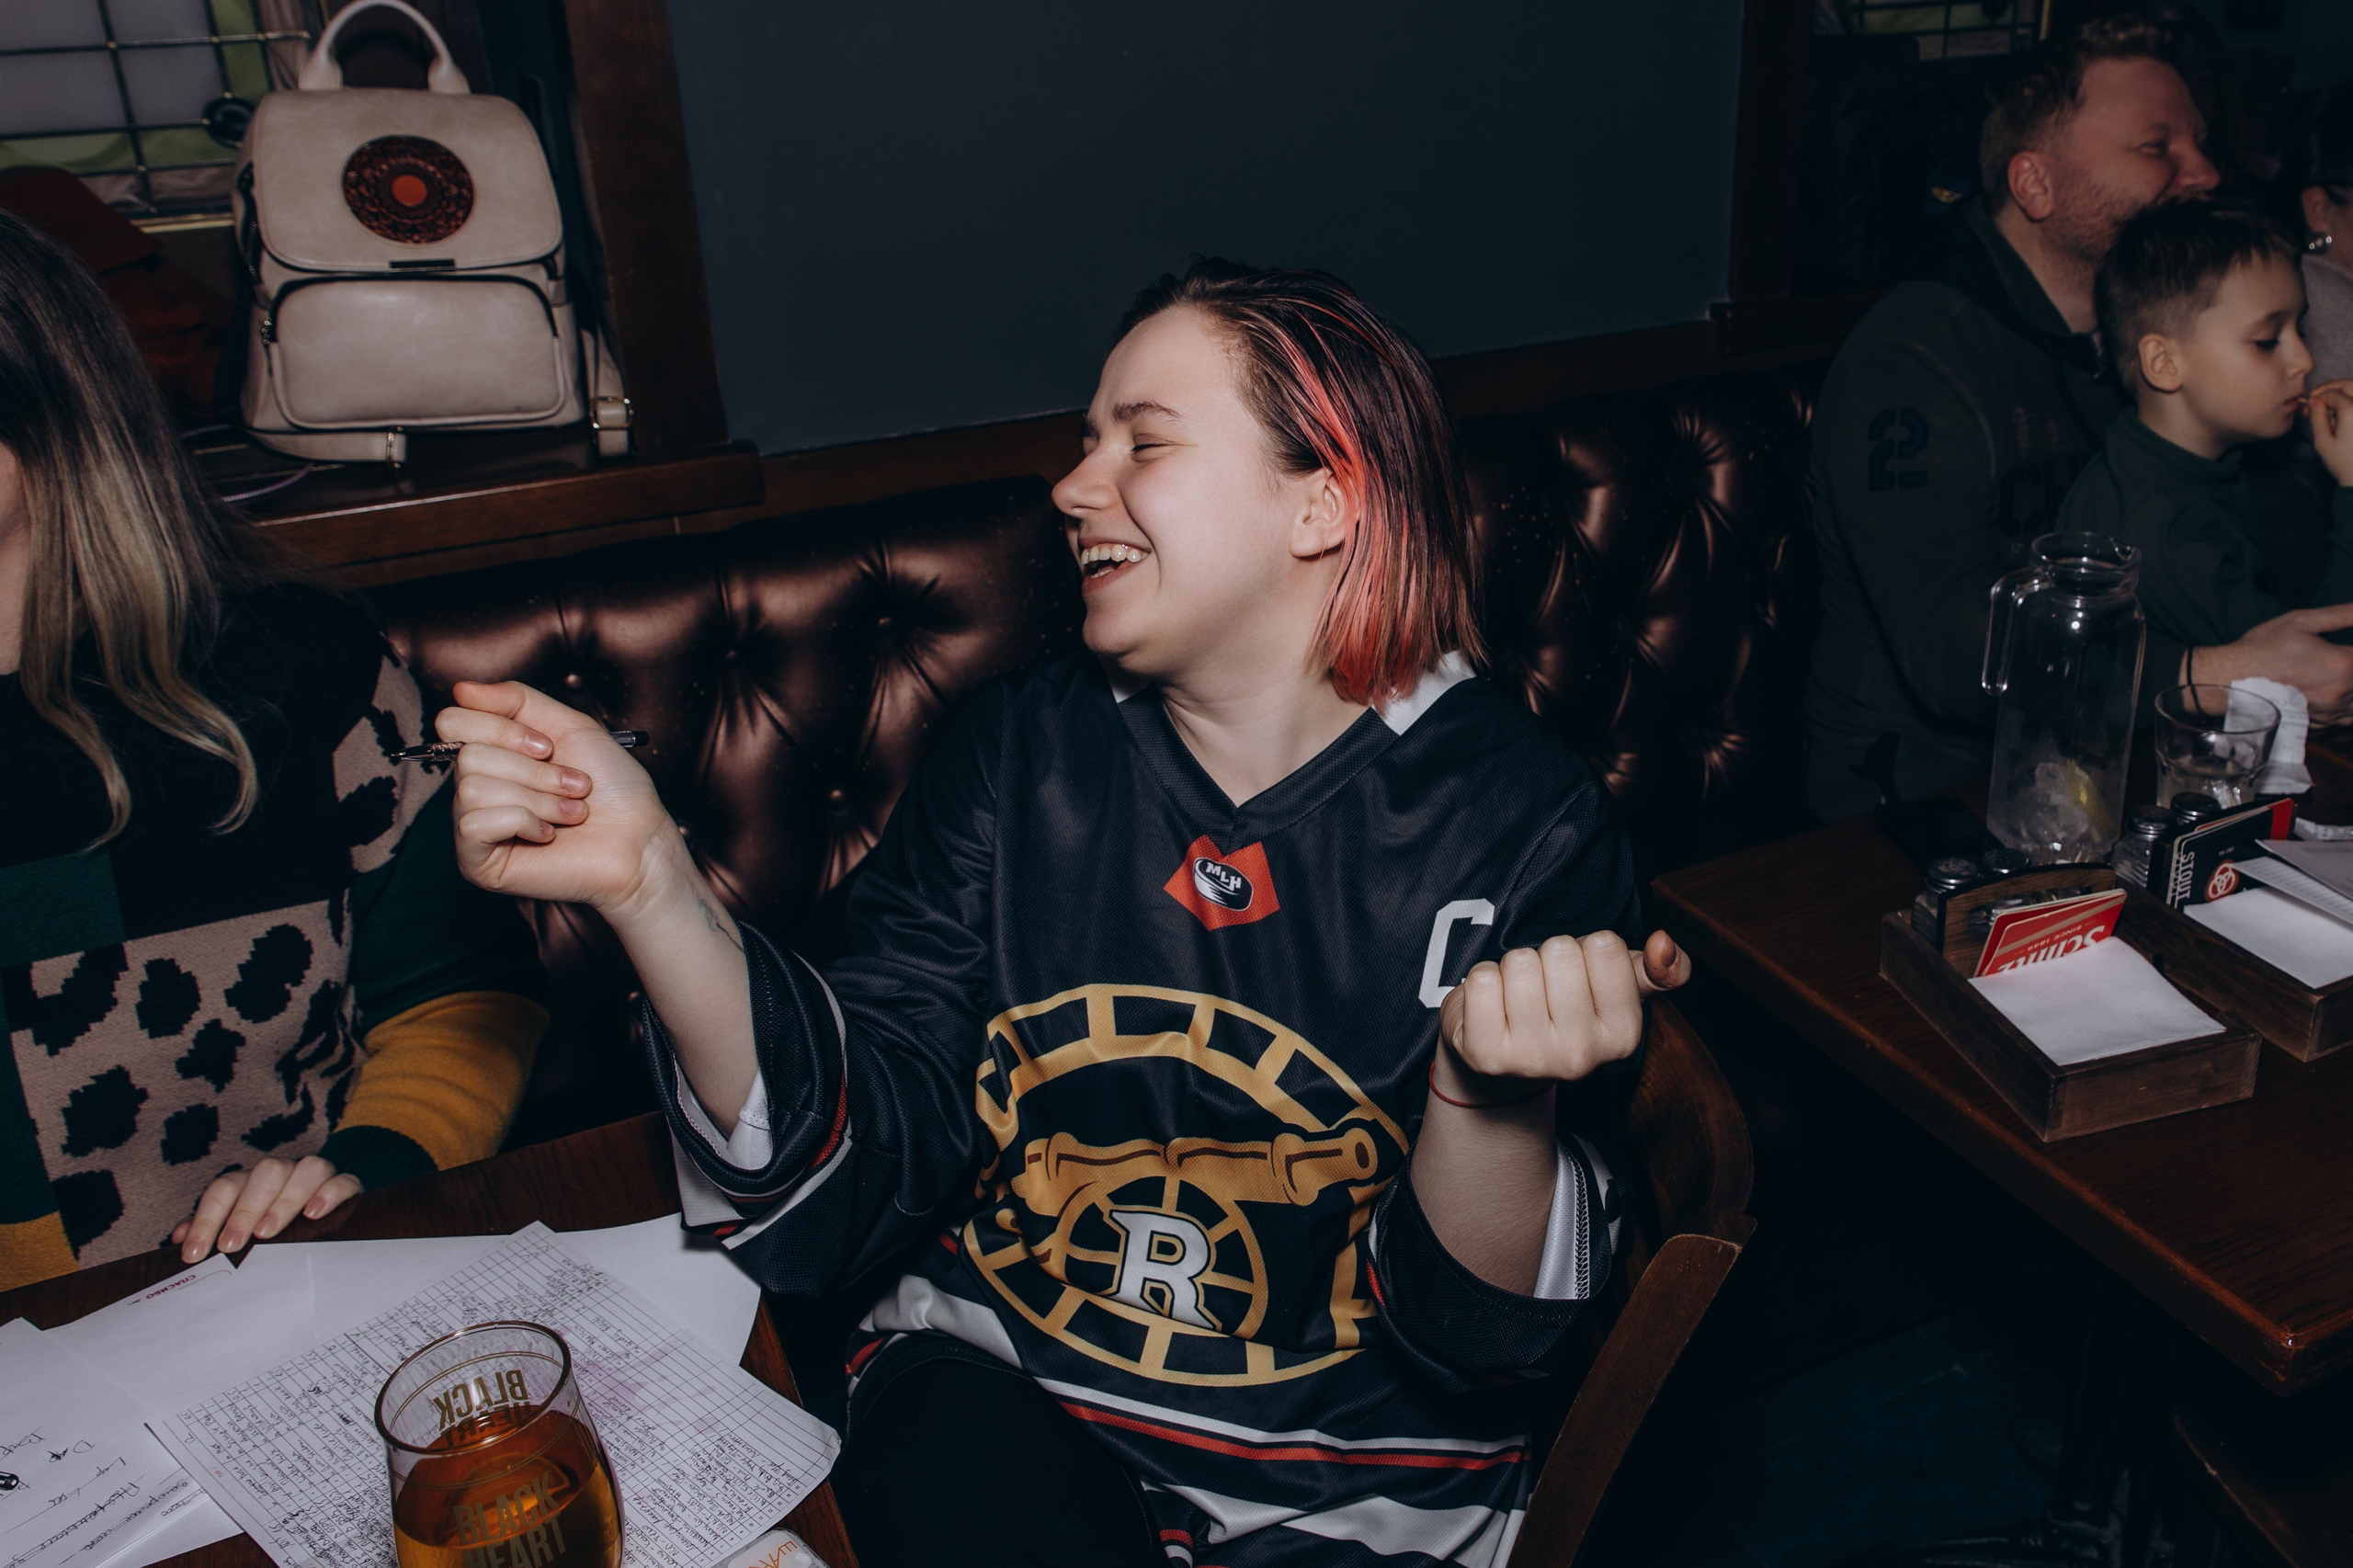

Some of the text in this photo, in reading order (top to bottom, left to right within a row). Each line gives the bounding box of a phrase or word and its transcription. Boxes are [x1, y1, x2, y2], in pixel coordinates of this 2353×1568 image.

[1205, 860, 1243, 892] MLH
[2177, 851, 2195, 899] STOUT
[1418, 898, 1495, 1008] C
[2053, 924, 2082, 941] SINCE
[145, 1274, 197, 1300] СПАСИБО
[1108, 1210, 1218, 1329] R
[452, 1471, 560, 1546] BLACK
[462, 1512, 567, 1568] HEART
